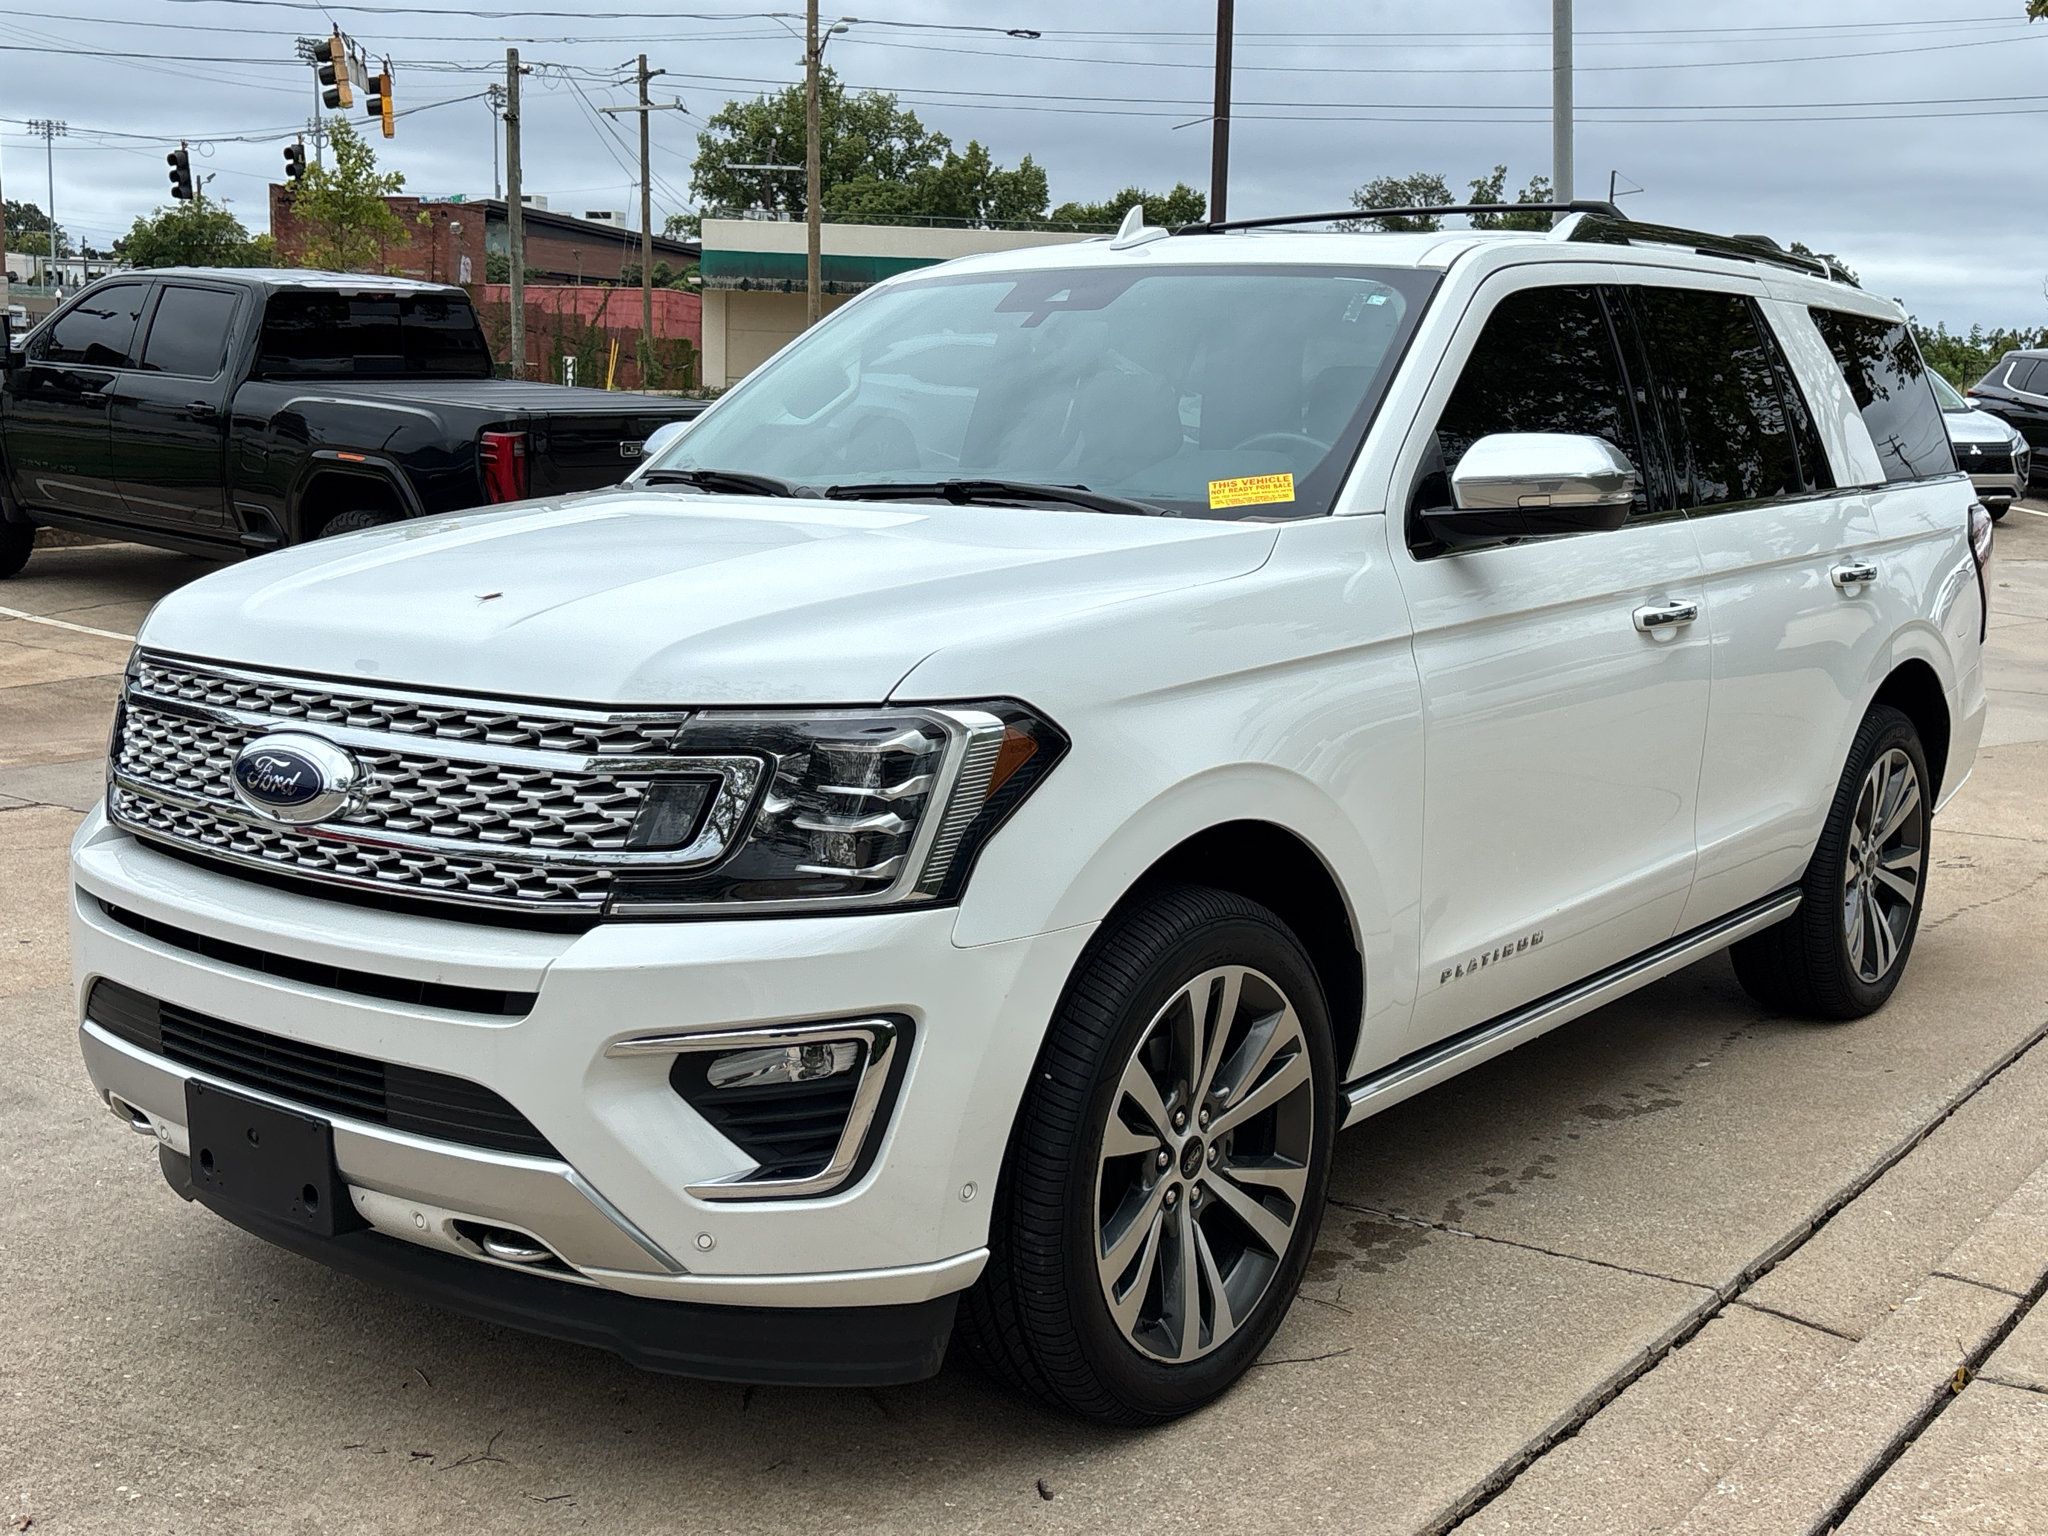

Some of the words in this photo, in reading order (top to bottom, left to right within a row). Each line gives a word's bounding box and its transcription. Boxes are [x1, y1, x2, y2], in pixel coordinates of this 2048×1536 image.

[1211, 480, 1238, 489] THIS
[1241, 475, 1291, 486] VEHICLE
[246, 755, 302, 796] Ford
[1440, 929, 1544, 984] PLATINUM
